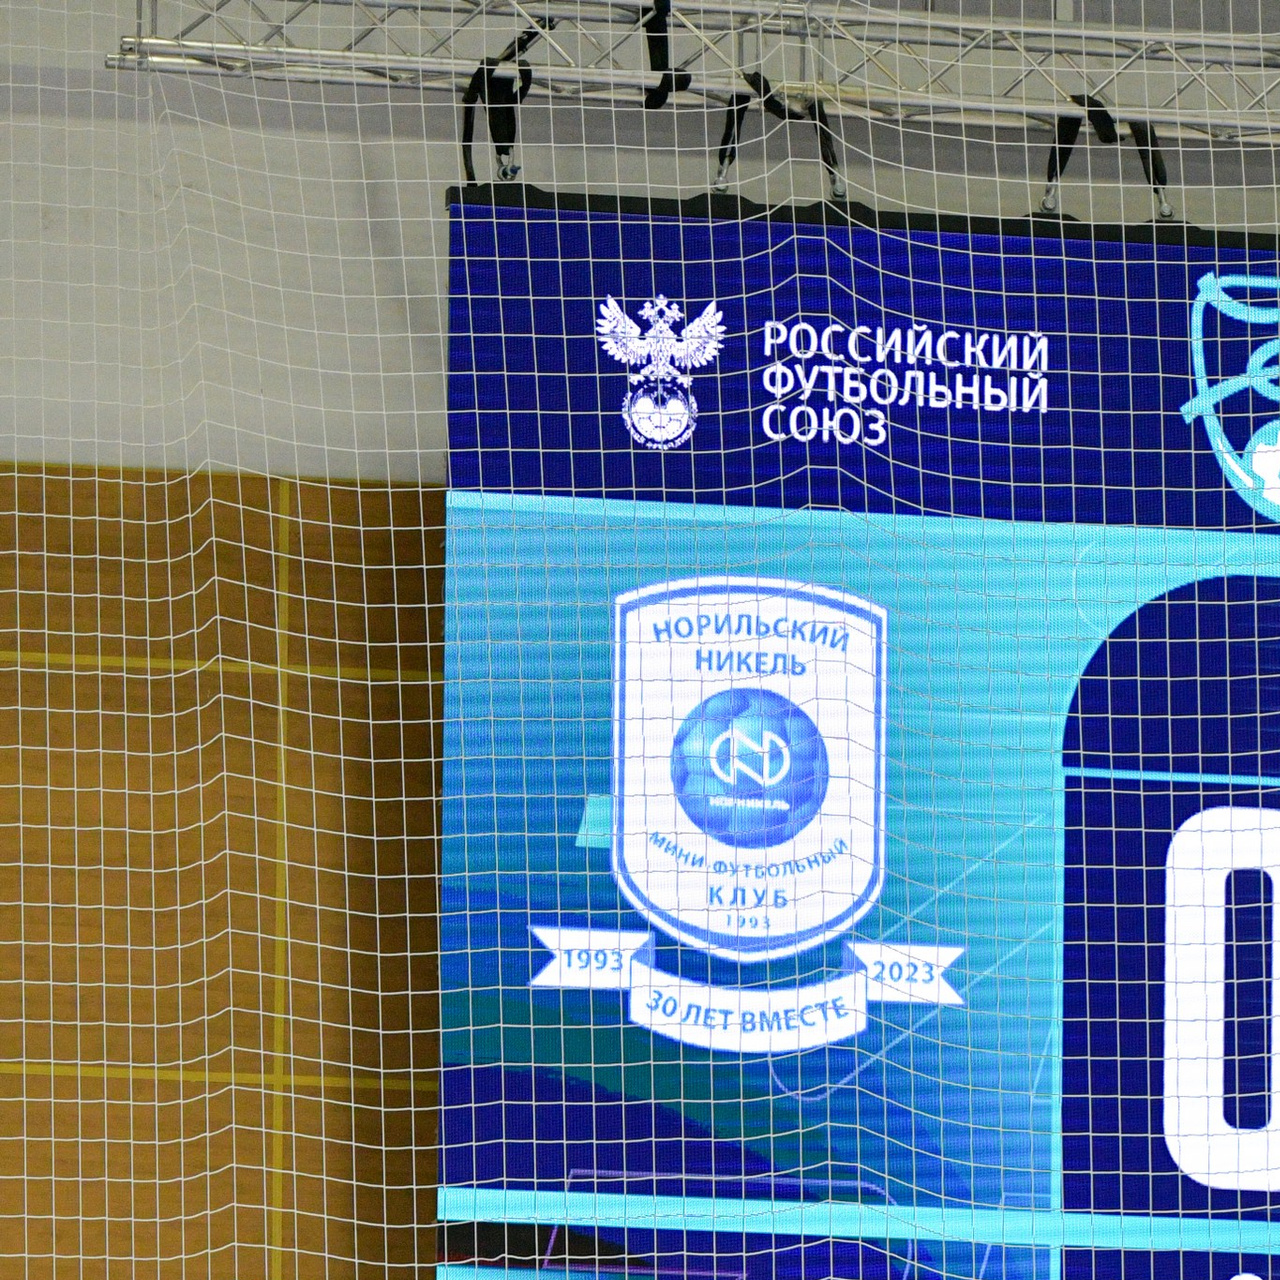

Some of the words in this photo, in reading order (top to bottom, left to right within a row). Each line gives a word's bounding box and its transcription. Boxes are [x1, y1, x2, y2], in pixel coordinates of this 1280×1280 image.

[763, 320, 1049, 371] РОССИЙСКИЙ
[762, 361, 1049, 413] ФУТБОЛЬНЫЙ
[762, 404, 887, 446] СОЮЗ
[653, 613, 850, 651] НОРИЛЬСКИЙ
[695, 649, 807, 676] НИКЕЛЬ
[709, 885, 789, 908] КЛУБ
[725, 914, 770, 930] 1993
[563, 949, 623, 971] 1993
[873, 961, 934, 984] 2023
[645, 990, 677, 1017] 30
[681, 1004, 732, 1031] ЛЕТ
[740, 997, 848, 1034] ВМЕСТЕ
